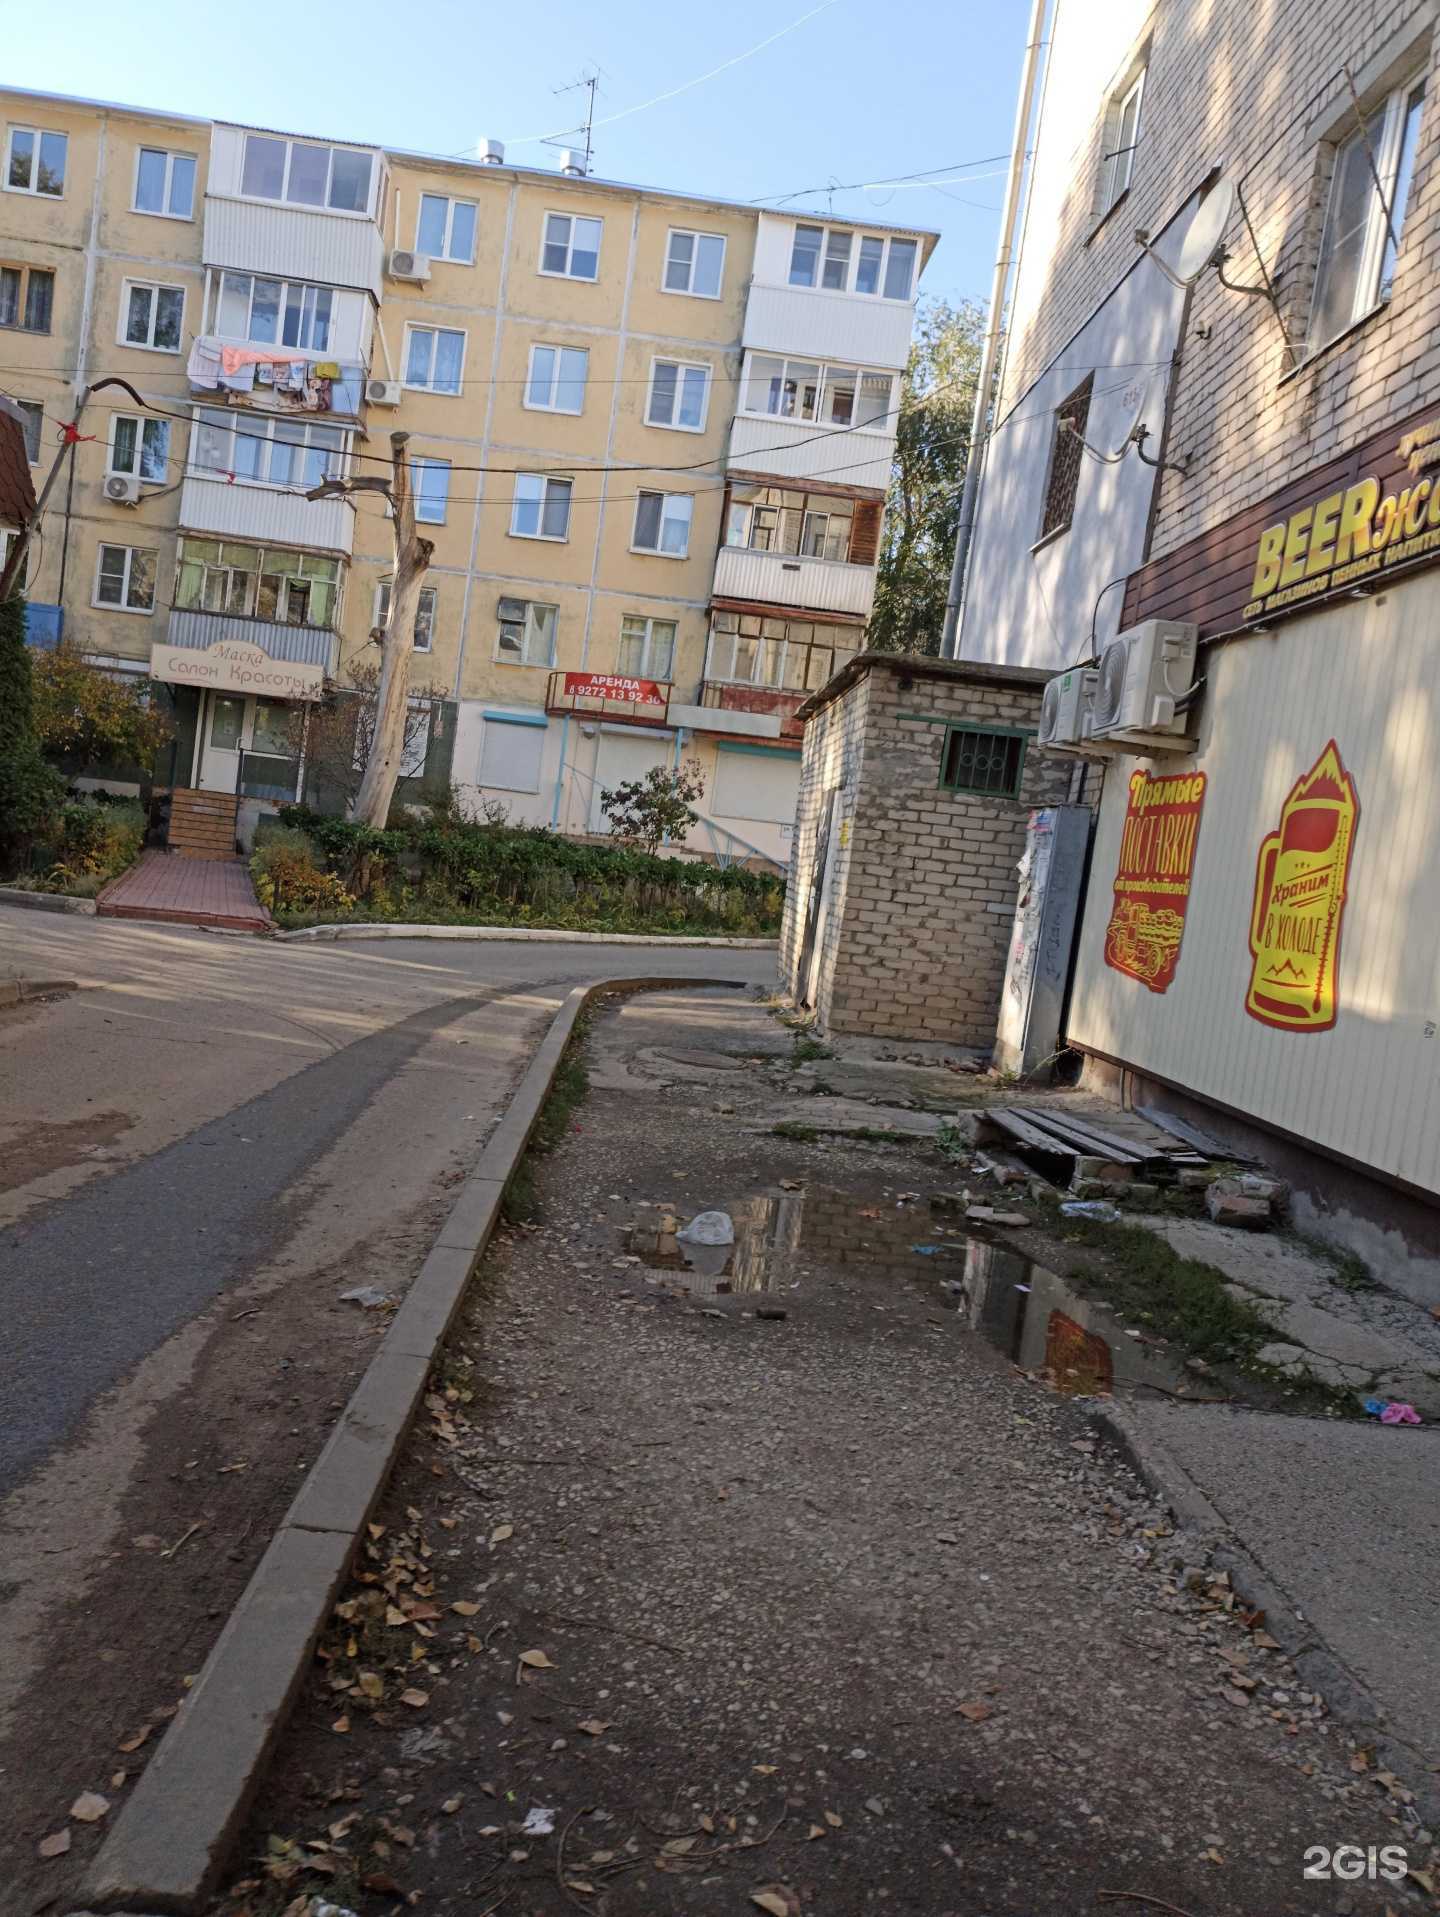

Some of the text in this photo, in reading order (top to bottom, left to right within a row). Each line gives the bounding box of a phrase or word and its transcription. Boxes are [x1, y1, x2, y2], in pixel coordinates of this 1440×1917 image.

[168, 657, 306, 690] Салон Красоты
[212, 645, 264, 668] Маска
[578, 685, 607, 697] 9272
[611, 688, 625, 700] 13
[628, 690, 643, 703] 92
[590, 675, 640, 690] АРЕНДА
[1130, 774, 1204, 816] Прямые
[1120, 812, 1198, 876] ПОСТАВКИ
[1272, 872, 1330, 907] Храним
[1264, 912, 1323, 955] В ХОЛОДЕ
